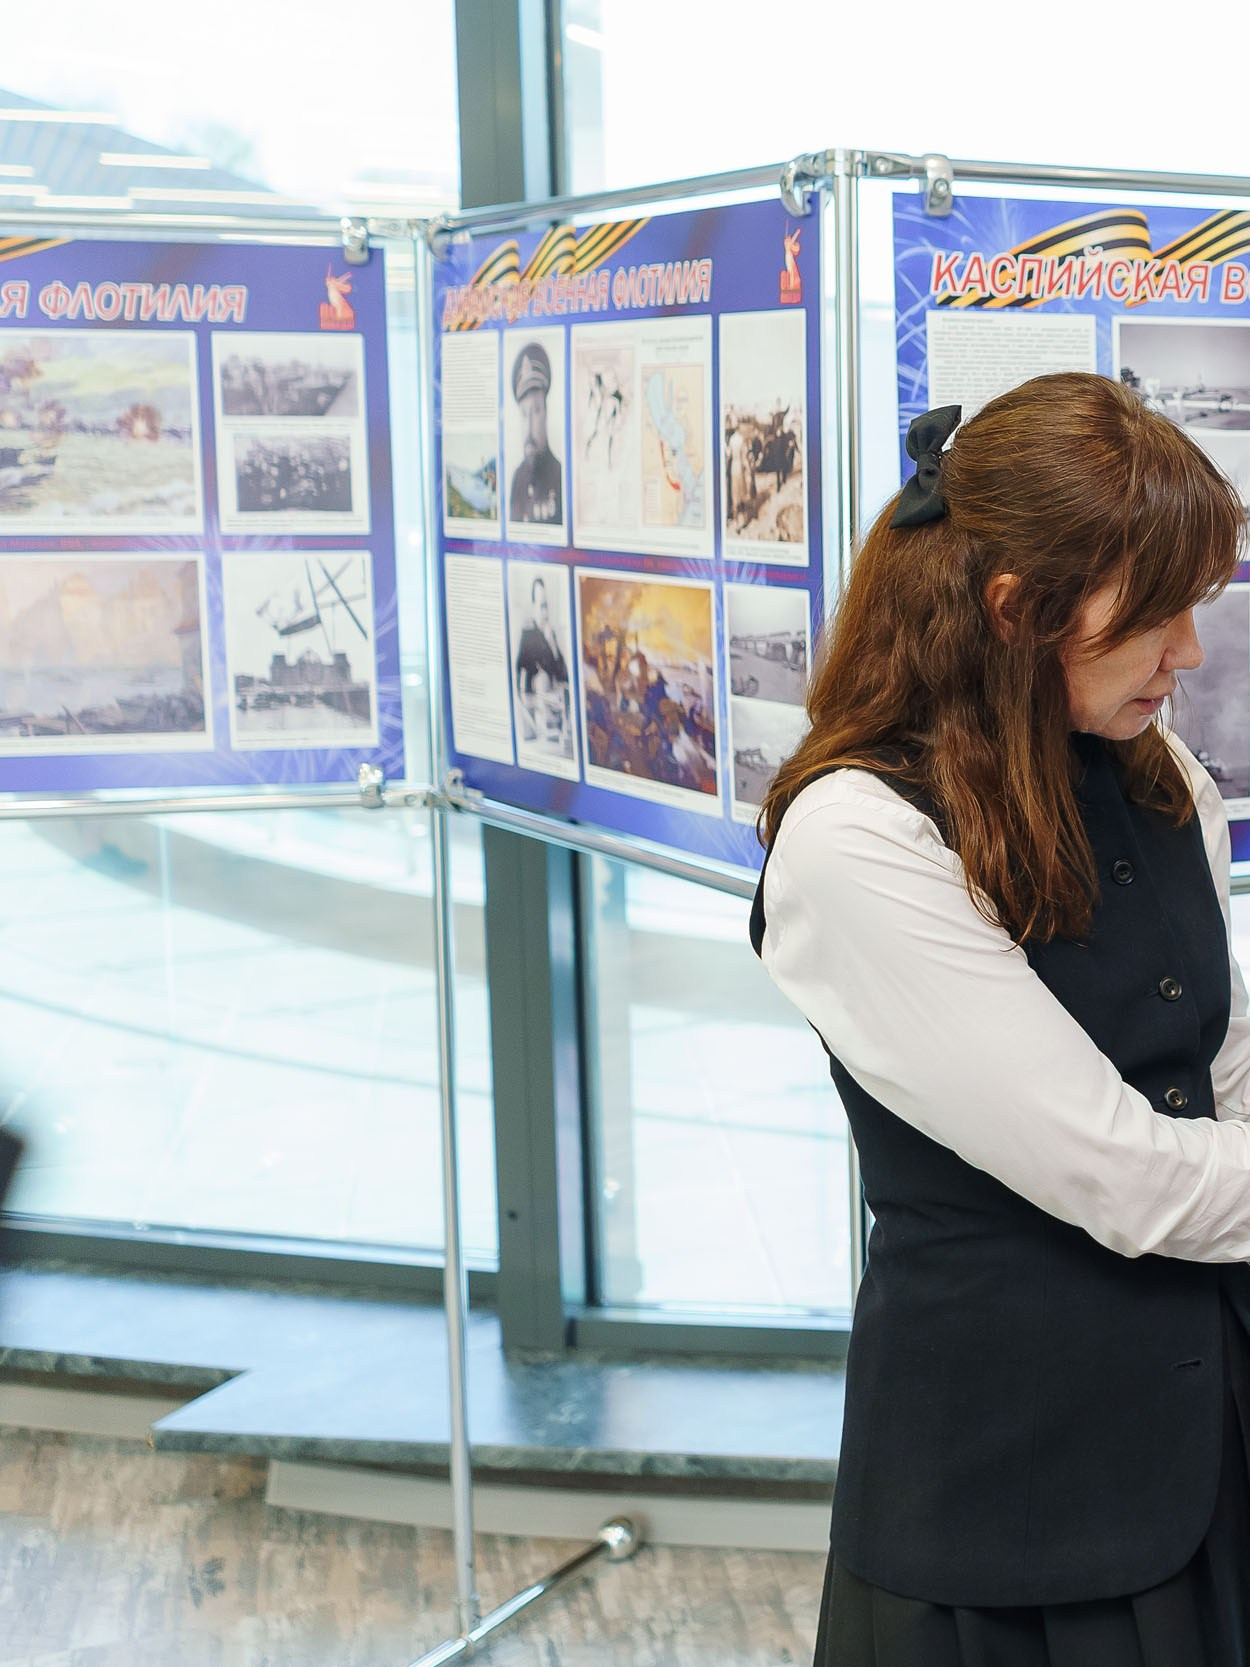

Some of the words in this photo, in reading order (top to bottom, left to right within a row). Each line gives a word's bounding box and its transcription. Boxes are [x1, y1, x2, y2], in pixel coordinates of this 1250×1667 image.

[38, 280, 249, 324] ФЛОТИЛИЯ
[533, 268, 611, 316] ВОЕННАЯ
[612, 257, 713, 311] ФЛОТИЛИЯ
[931, 247, 1214, 304] КАСПИЙСКАЯ
